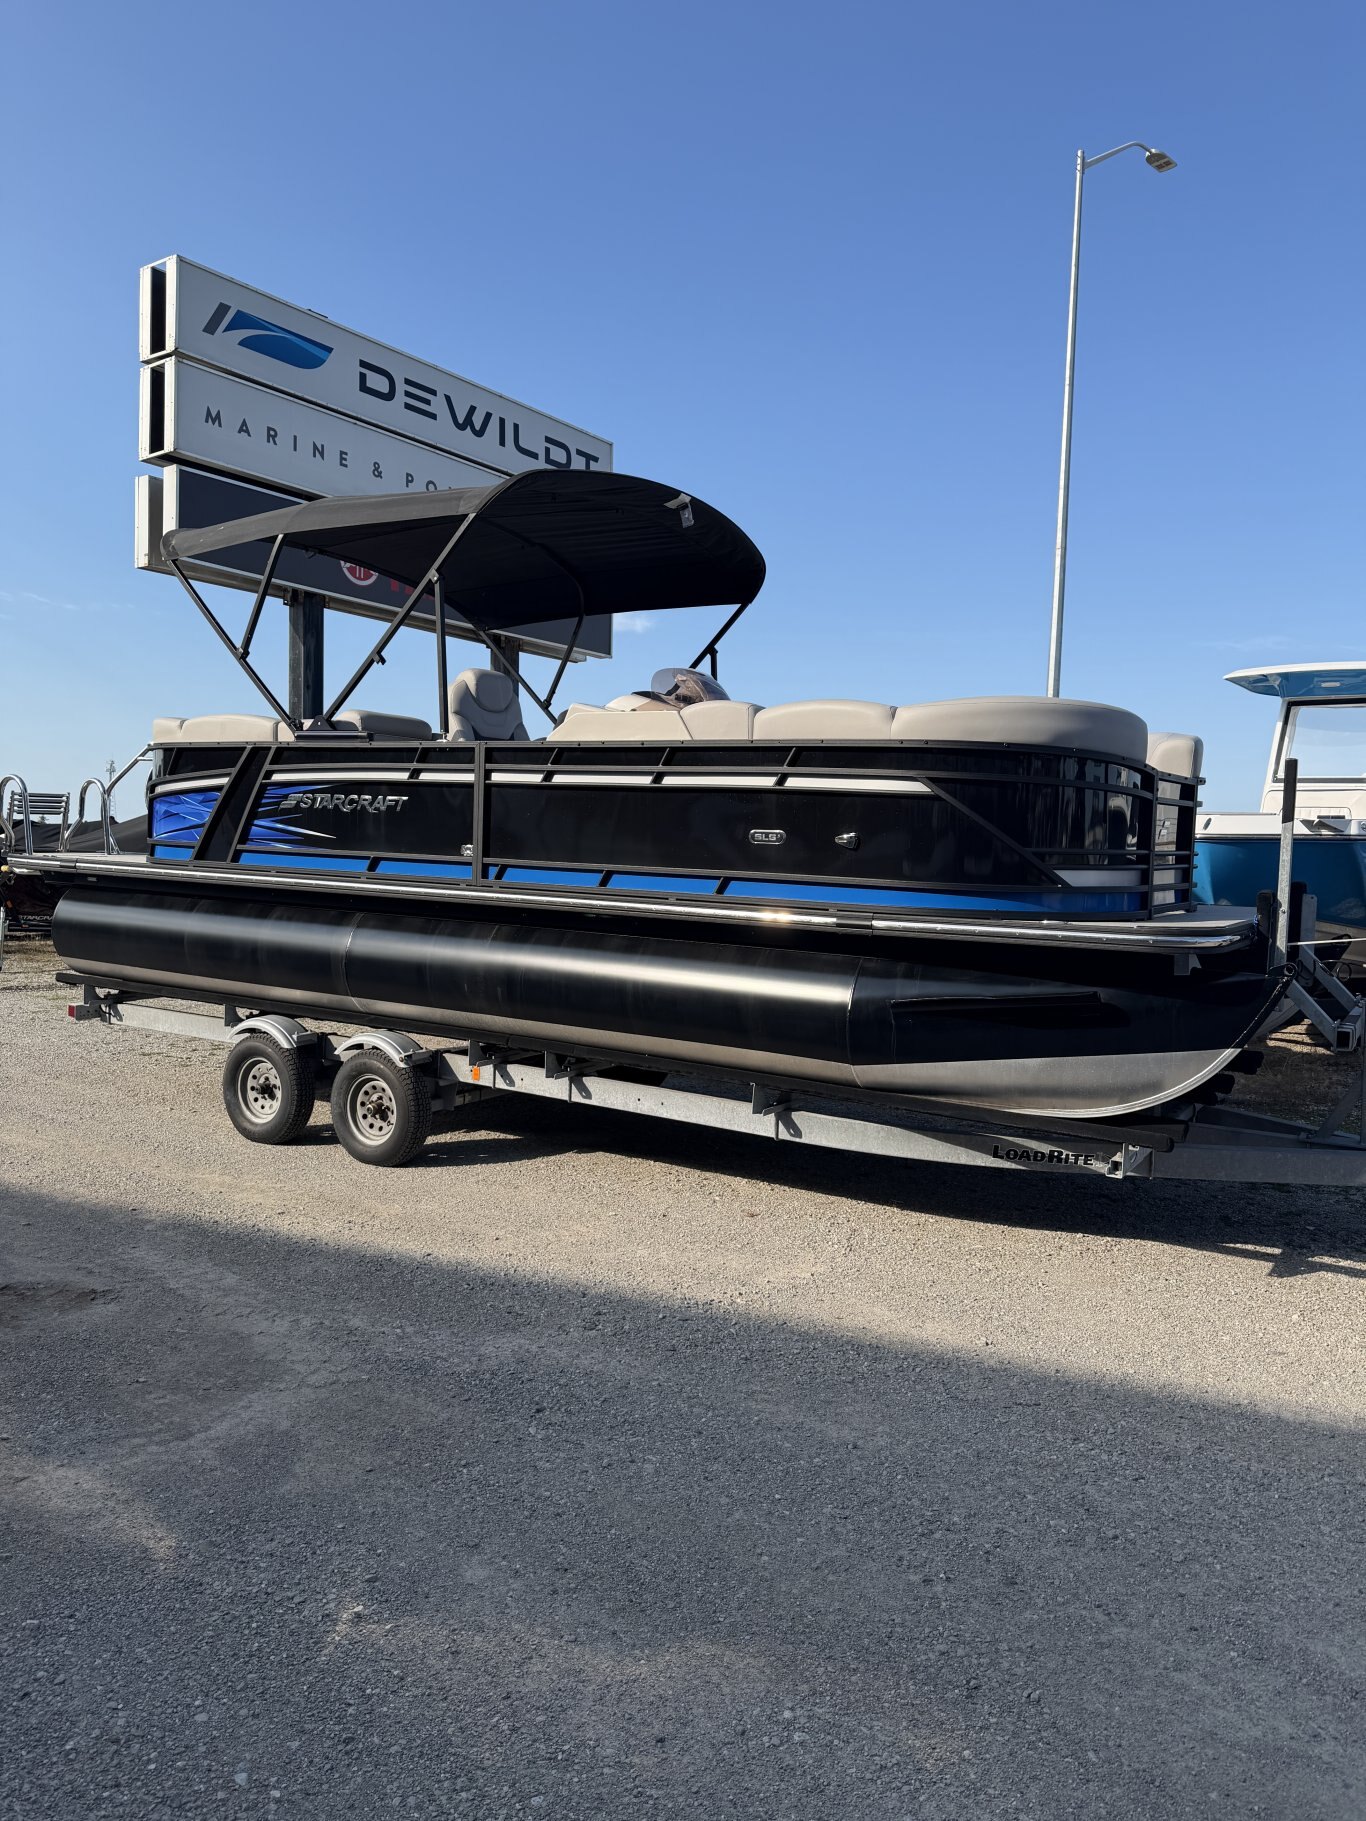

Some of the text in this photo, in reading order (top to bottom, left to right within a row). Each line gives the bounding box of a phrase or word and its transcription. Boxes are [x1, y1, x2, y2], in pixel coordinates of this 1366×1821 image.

[204, 405, 452, 492] MARINE & PO
[359, 358, 600, 470] DEWILDT
[299, 793, 409, 813] STARCRAFT
